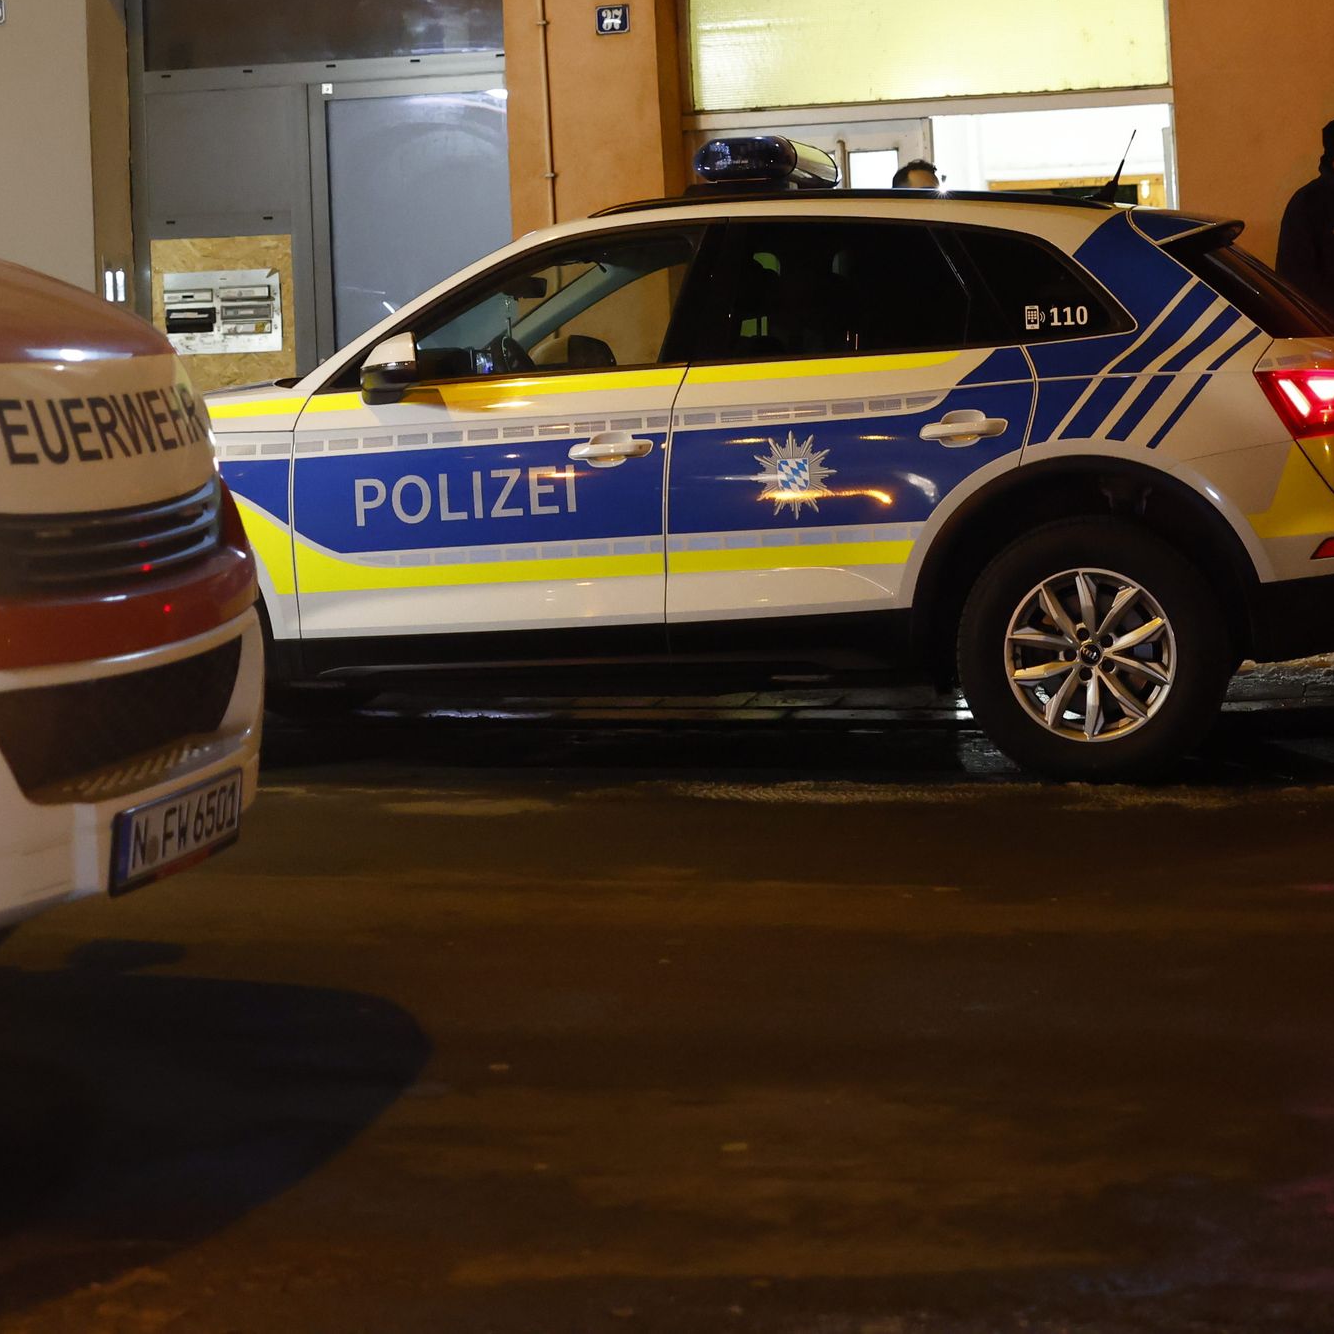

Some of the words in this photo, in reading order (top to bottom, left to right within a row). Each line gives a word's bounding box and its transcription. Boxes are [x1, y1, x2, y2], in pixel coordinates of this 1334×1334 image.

[1049, 305, 1089, 327] 110
[354, 464, 578, 527] POLIZEI
[131, 816, 149, 870] N
